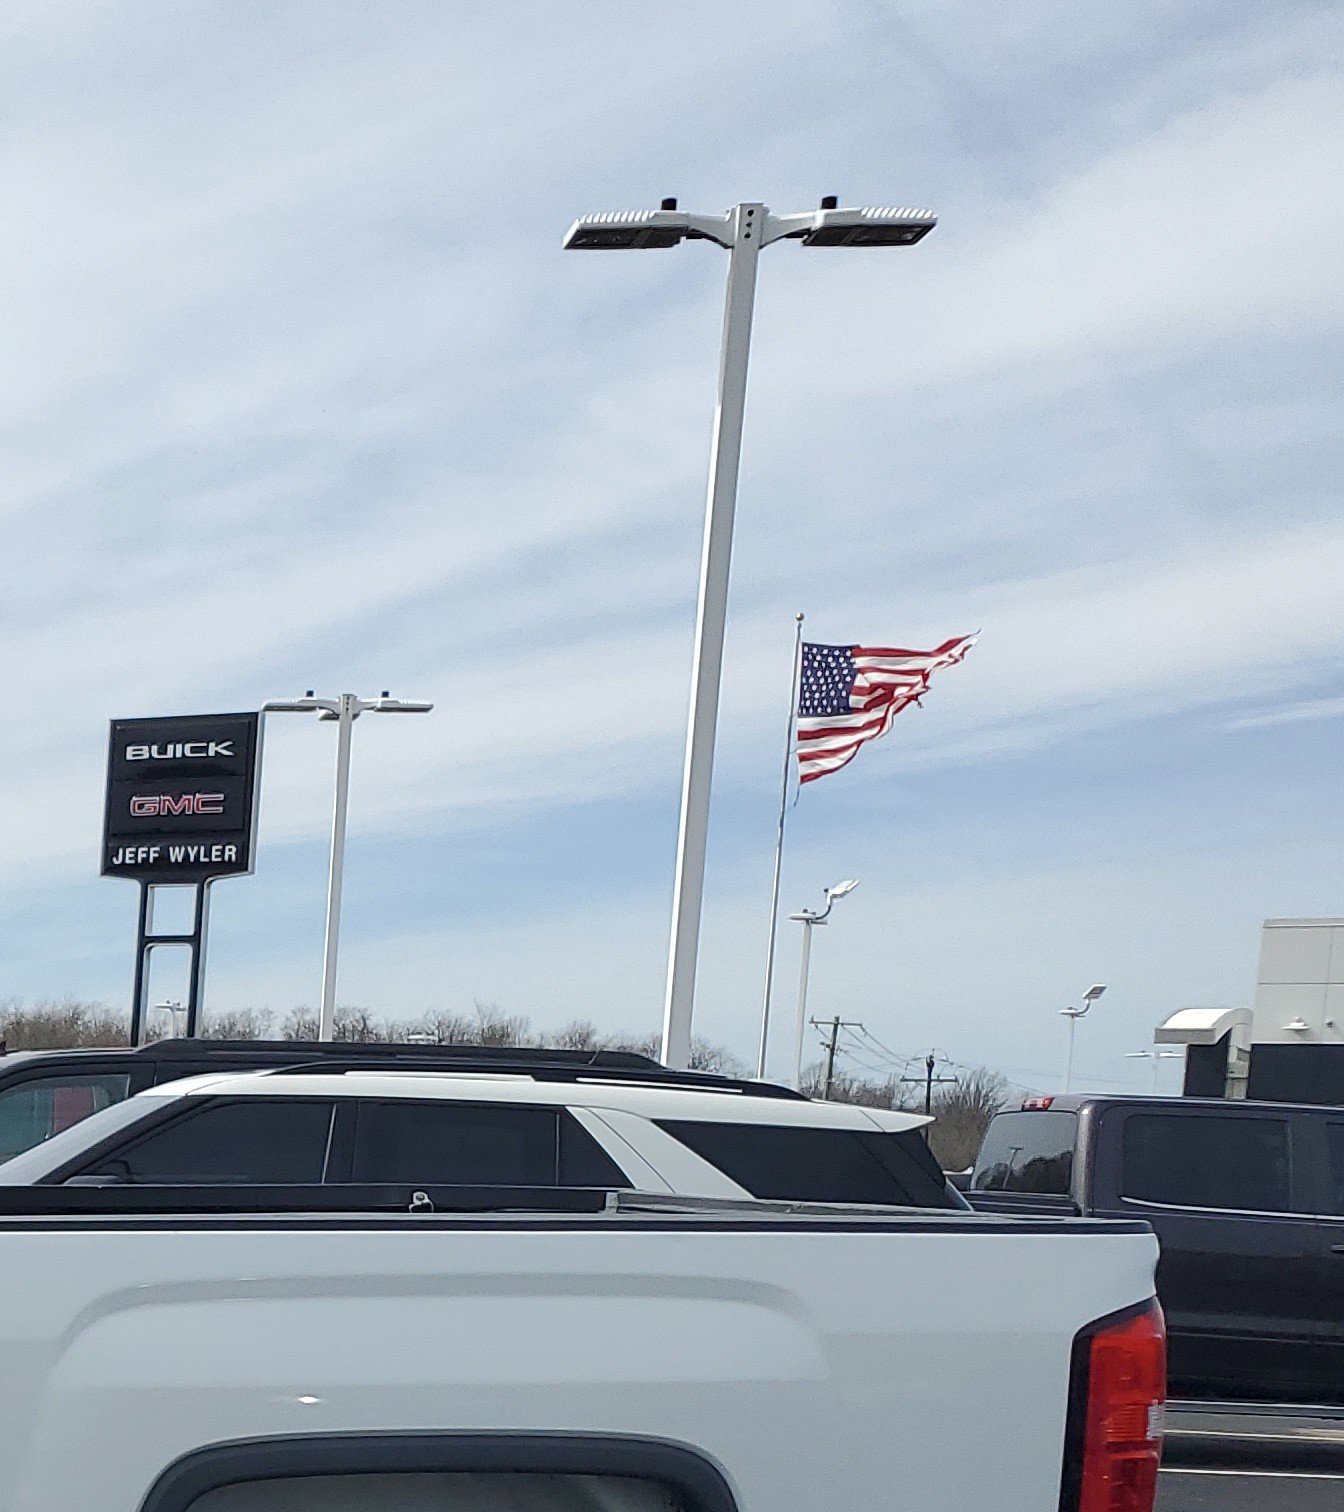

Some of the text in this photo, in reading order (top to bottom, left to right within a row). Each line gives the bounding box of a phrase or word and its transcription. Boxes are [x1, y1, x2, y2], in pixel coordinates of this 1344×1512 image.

[125, 741, 234, 760] BUICK
[130, 793, 224, 816] GMC
[112, 844, 237, 865] JEFF WYLER
